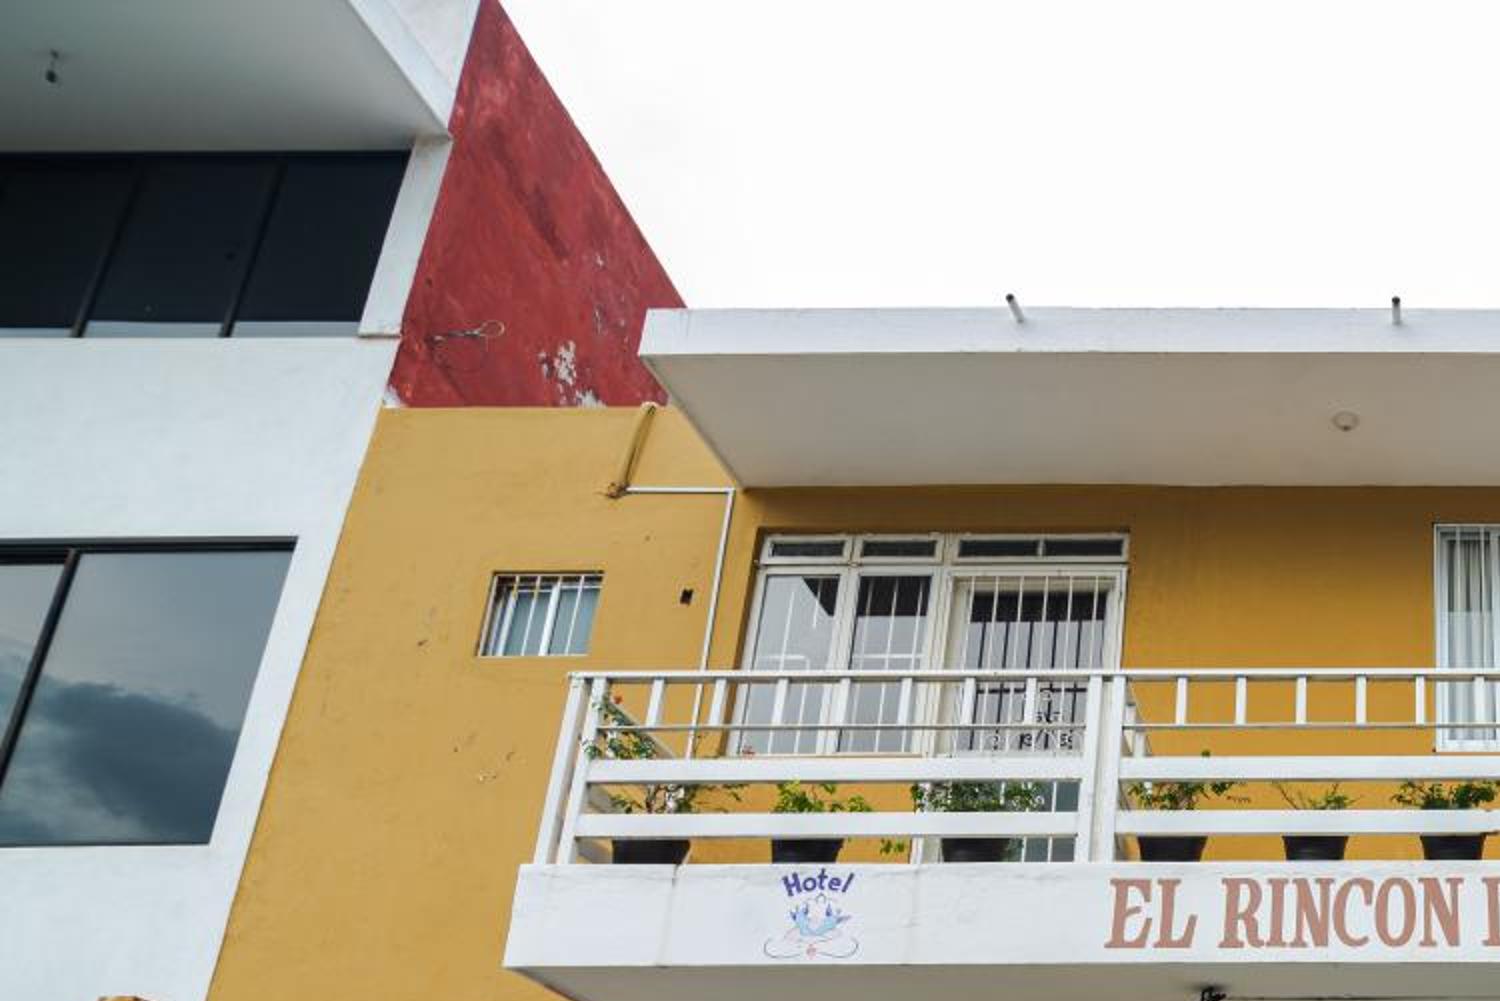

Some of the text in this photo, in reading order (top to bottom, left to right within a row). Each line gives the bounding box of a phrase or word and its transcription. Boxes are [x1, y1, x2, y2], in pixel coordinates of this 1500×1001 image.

[779, 866, 854, 897] Hotel
[1105, 877, 1196, 949] EL
[1219, 877, 1461, 949] RINCON
